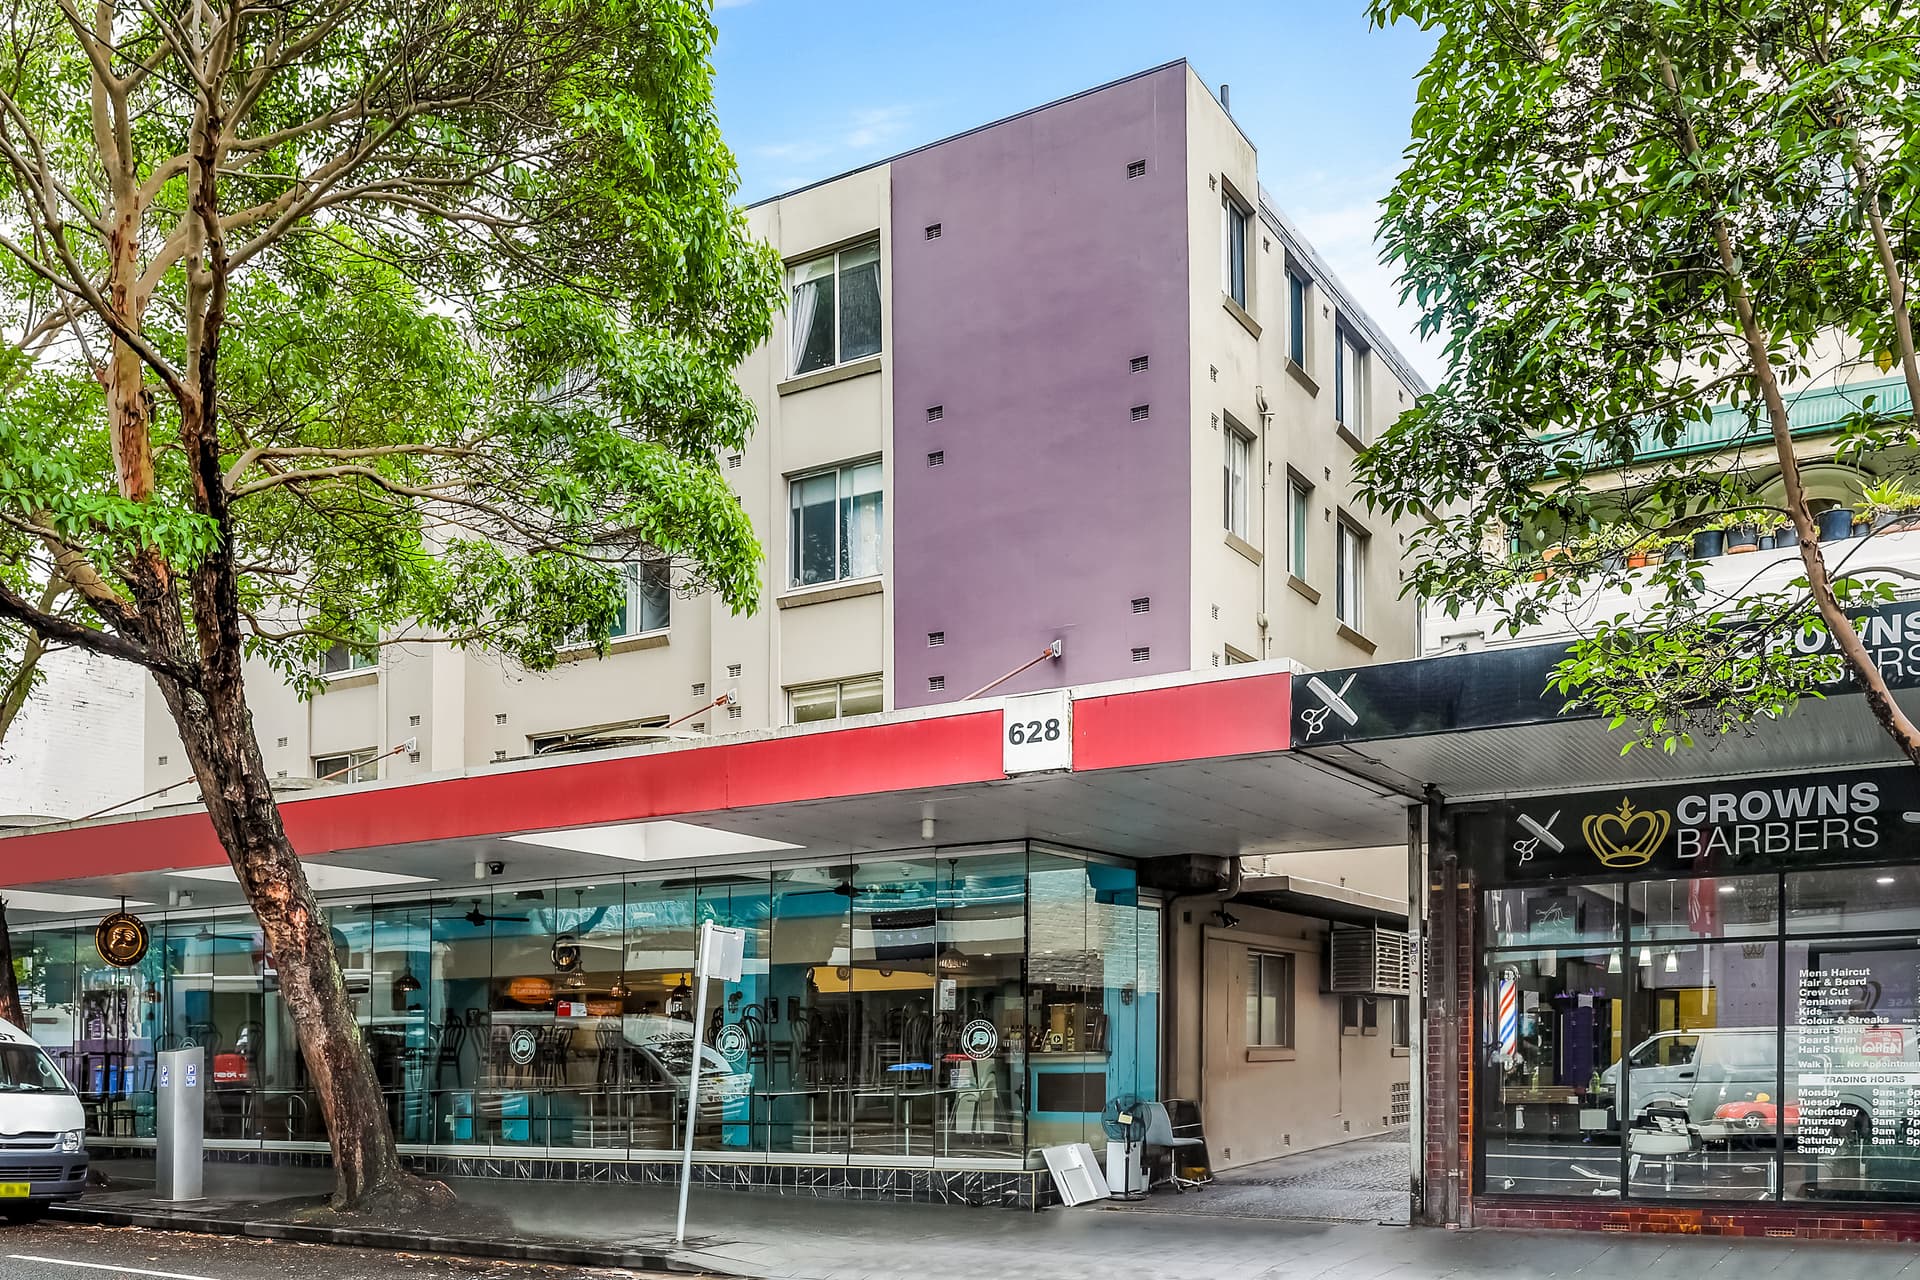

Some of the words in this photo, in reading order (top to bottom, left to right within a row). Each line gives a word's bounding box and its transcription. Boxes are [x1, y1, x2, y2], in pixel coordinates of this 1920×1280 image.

[1732, 643, 1920, 692] BBRS
[1009, 718, 1060, 745] 628
[1676, 782, 1880, 825] CROWNS
[1677, 816, 1879, 859] BARBERS
[1799, 969, 1828, 977] Mens
[1831, 968, 1871, 977] Haircut
[1799, 978, 1821, 987] Hair
[1835, 978, 1867, 986] Beard
[1799, 989, 1827, 997] Crew
[1830, 988, 1849, 996] Cut
[1799, 998, 1853, 1006] Pensioner
[1799, 1007, 1823, 1015] Kids
[1799, 1017, 1835, 1025] Colour
[1837, 1016, 1845, 1024] &
[1848, 1016, 1889, 1024] Streaks
[1799, 1026, 1830, 1034] Beard
[1799, 1036, 1830, 1044] Beard
[1833, 1035, 1857, 1044] Trim
[1799, 1045, 1820, 1054] Hair
[1798, 1060, 1821, 1068] Walk
[1847, 1060, 1861, 1068] No
[1863, 1060, 1920, 1070] Appointmen
[1824, 1075, 1867, 1083] TRADING
[1870, 1075, 1906, 1083] HOURS
[1798, 1088, 1840, 1098] Monday
[1872, 1088, 1896, 1096] 9am
[1907, 1088, 1920, 1098] 6p
[1798, 1098, 1842, 1107] Tuesday
[1872, 1098, 1896, 1106] 9am
[1907, 1098, 1920, 1108] 6p
[1798, 1107, 1859, 1117] Wednesday
[1872, 1108, 1896, 1116] 9am
[1907, 1108, 1920, 1117] 6p
[1798, 1117, 1848, 1127] Thursday
[1872, 1117, 1896, 1125] 9am
[1907, 1117, 1920, 1127] 7p
[1798, 1127, 1831, 1136] Friday
[1907, 1127, 1920, 1136] 6p
[1798, 1136, 1845, 1146] Saturday
[1872, 1137, 1896, 1145] 9am
[1907, 1137, 1920, 1146] 5p
[1798, 1146, 1837, 1155] Sunday
